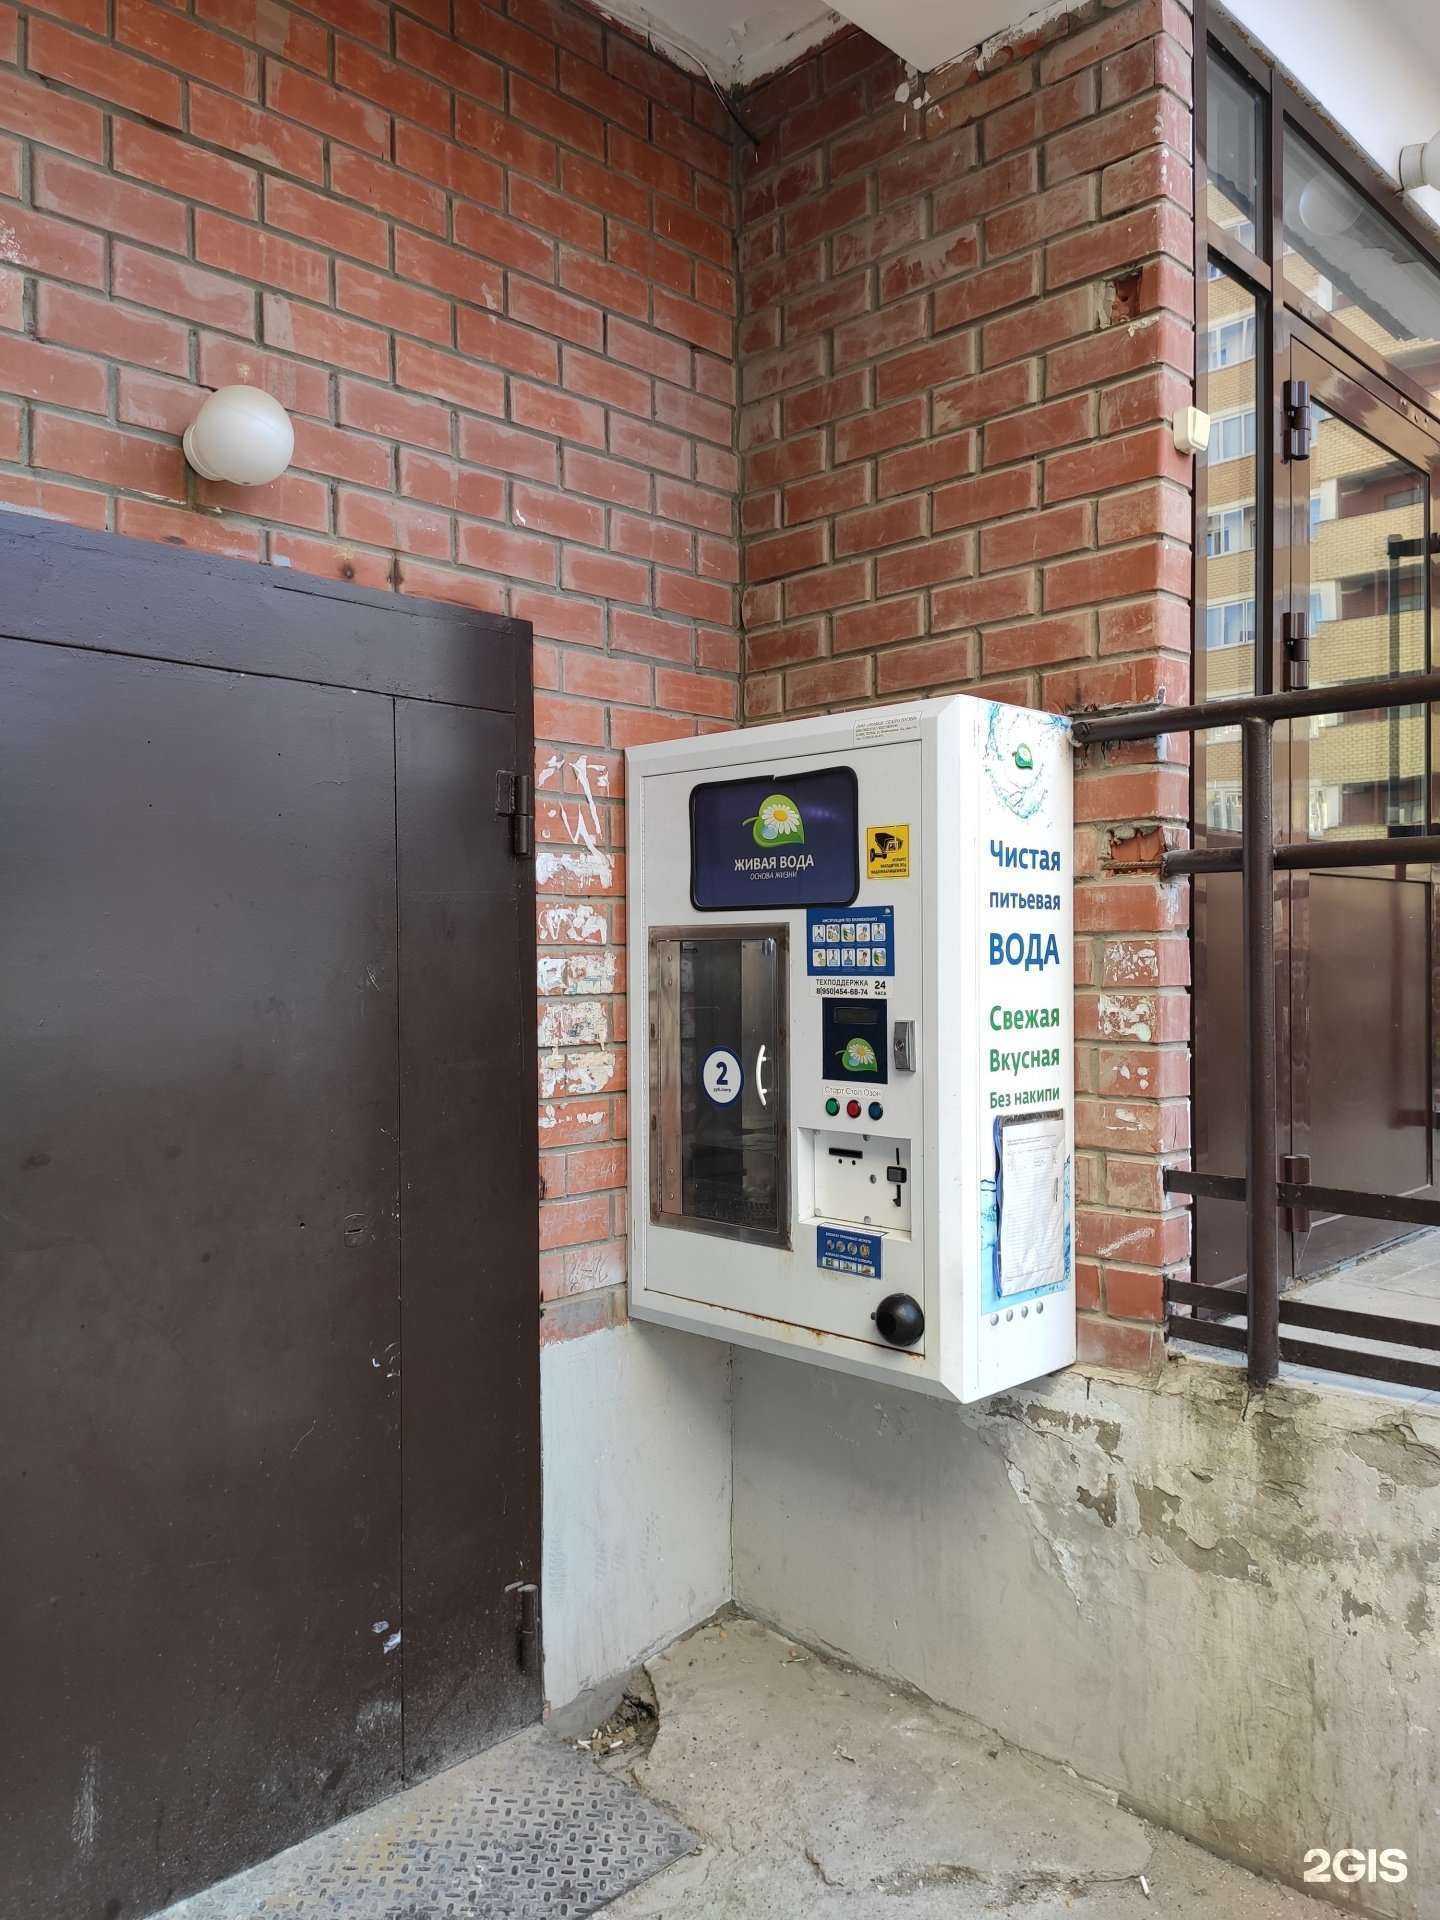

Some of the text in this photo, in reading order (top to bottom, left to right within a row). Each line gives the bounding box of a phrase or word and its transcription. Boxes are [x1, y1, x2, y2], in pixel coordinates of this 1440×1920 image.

[734, 854, 814, 871] ЖИВАЯ ВОДА
[990, 839, 1061, 871] Чистая
[989, 891, 1061, 910] питьевая
[989, 932, 1060, 972] ВОДА
[816, 979, 886, 990] ТЕХПОДДЕРЖКА 24
[990, 1005, 1060, 1031] Свежая
[716, 1061, 728, 1085] 2
[990, 1048, 1060, 1077] Вкусная
[990, 1087, 1060, 1109] Без накипи
